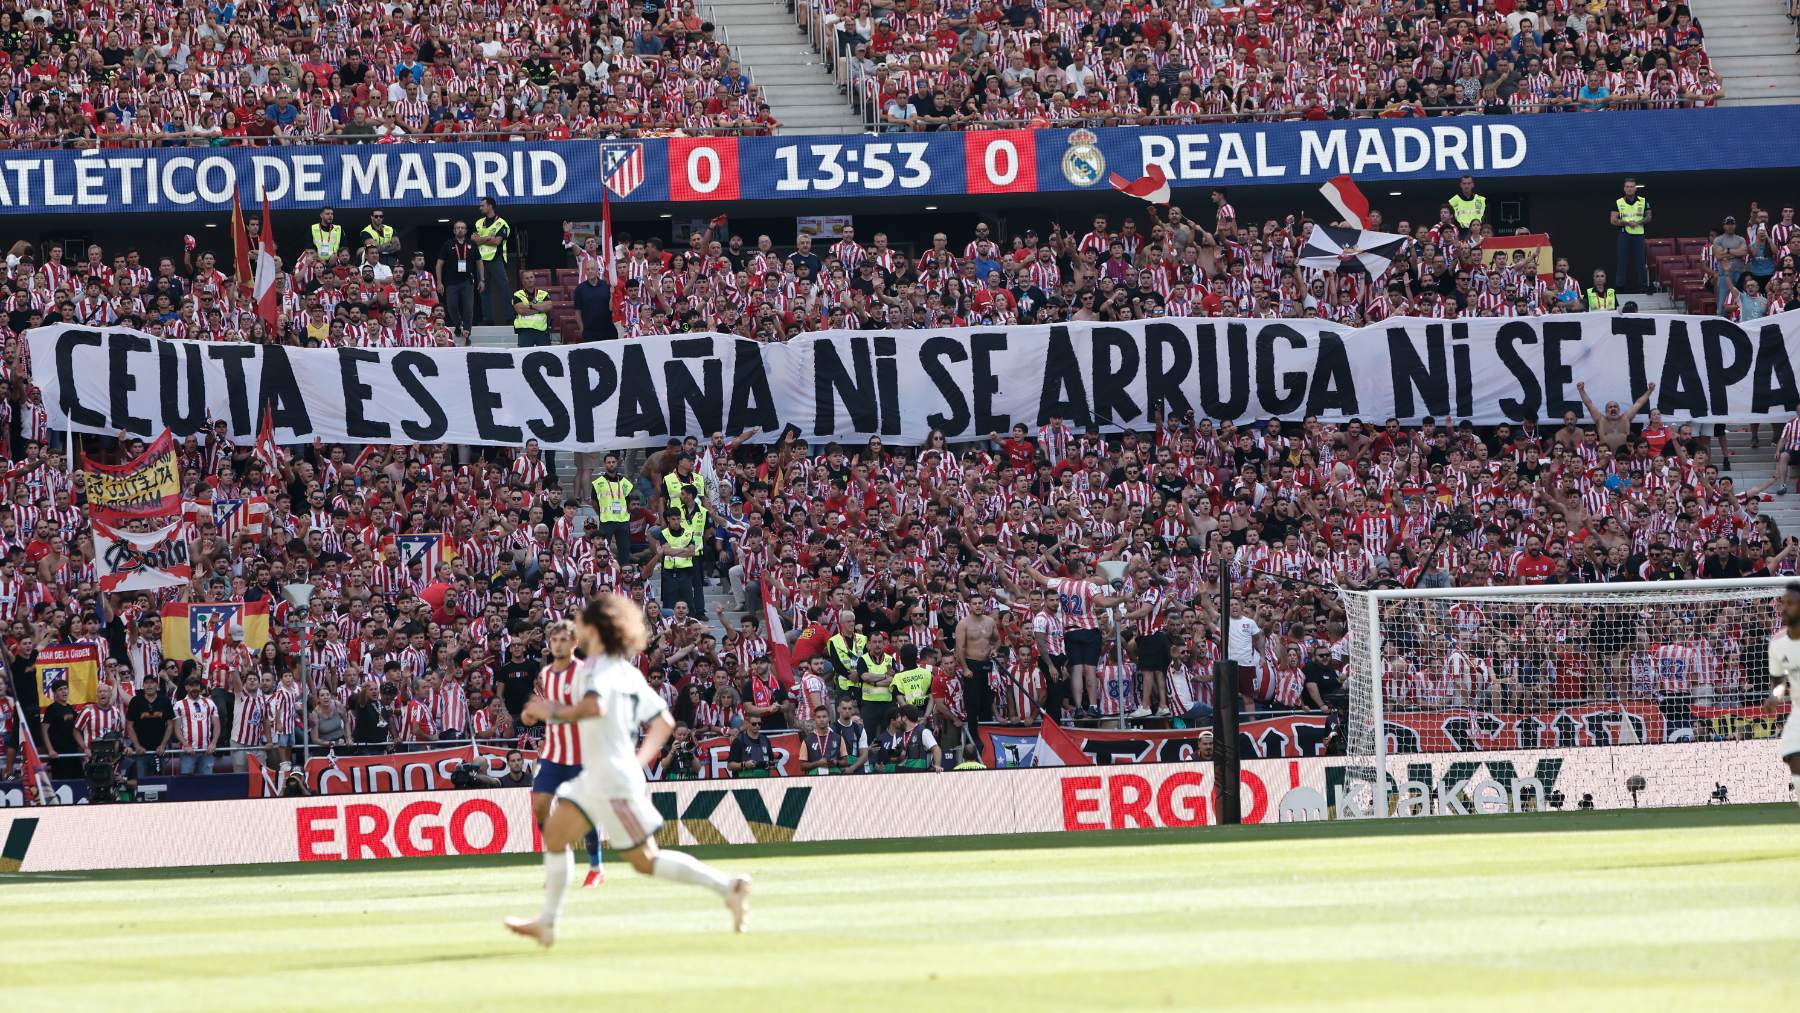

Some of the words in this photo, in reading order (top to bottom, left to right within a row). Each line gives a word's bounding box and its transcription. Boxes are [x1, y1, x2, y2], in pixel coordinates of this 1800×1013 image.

[252, 155, 325, 202] DE
[341, 150, 567, 200] MADRID
[687, 146, 721, 193] 0
[774, 142, 932, 191] 13:53
[984, 139, 1019, 186] 0
[1139, 132, 1286, 184] REAL
[1299, 124, 1527, 175] MADRID
[56, 329, 314, 437] CEUTA
[338, 347, 440, 442] ES
[466, 337, 780, 444] ESPAÑA
[918, 332, 1010, 441] SE
[1036, 322, 1360, 425] ARRUGA
[1495, 321, 1585, 422] SE
[1612, 317, 1800, 418] TAPA
[296, 798, 508, 862] ERGO
[650, 786, 812, 846] KV
